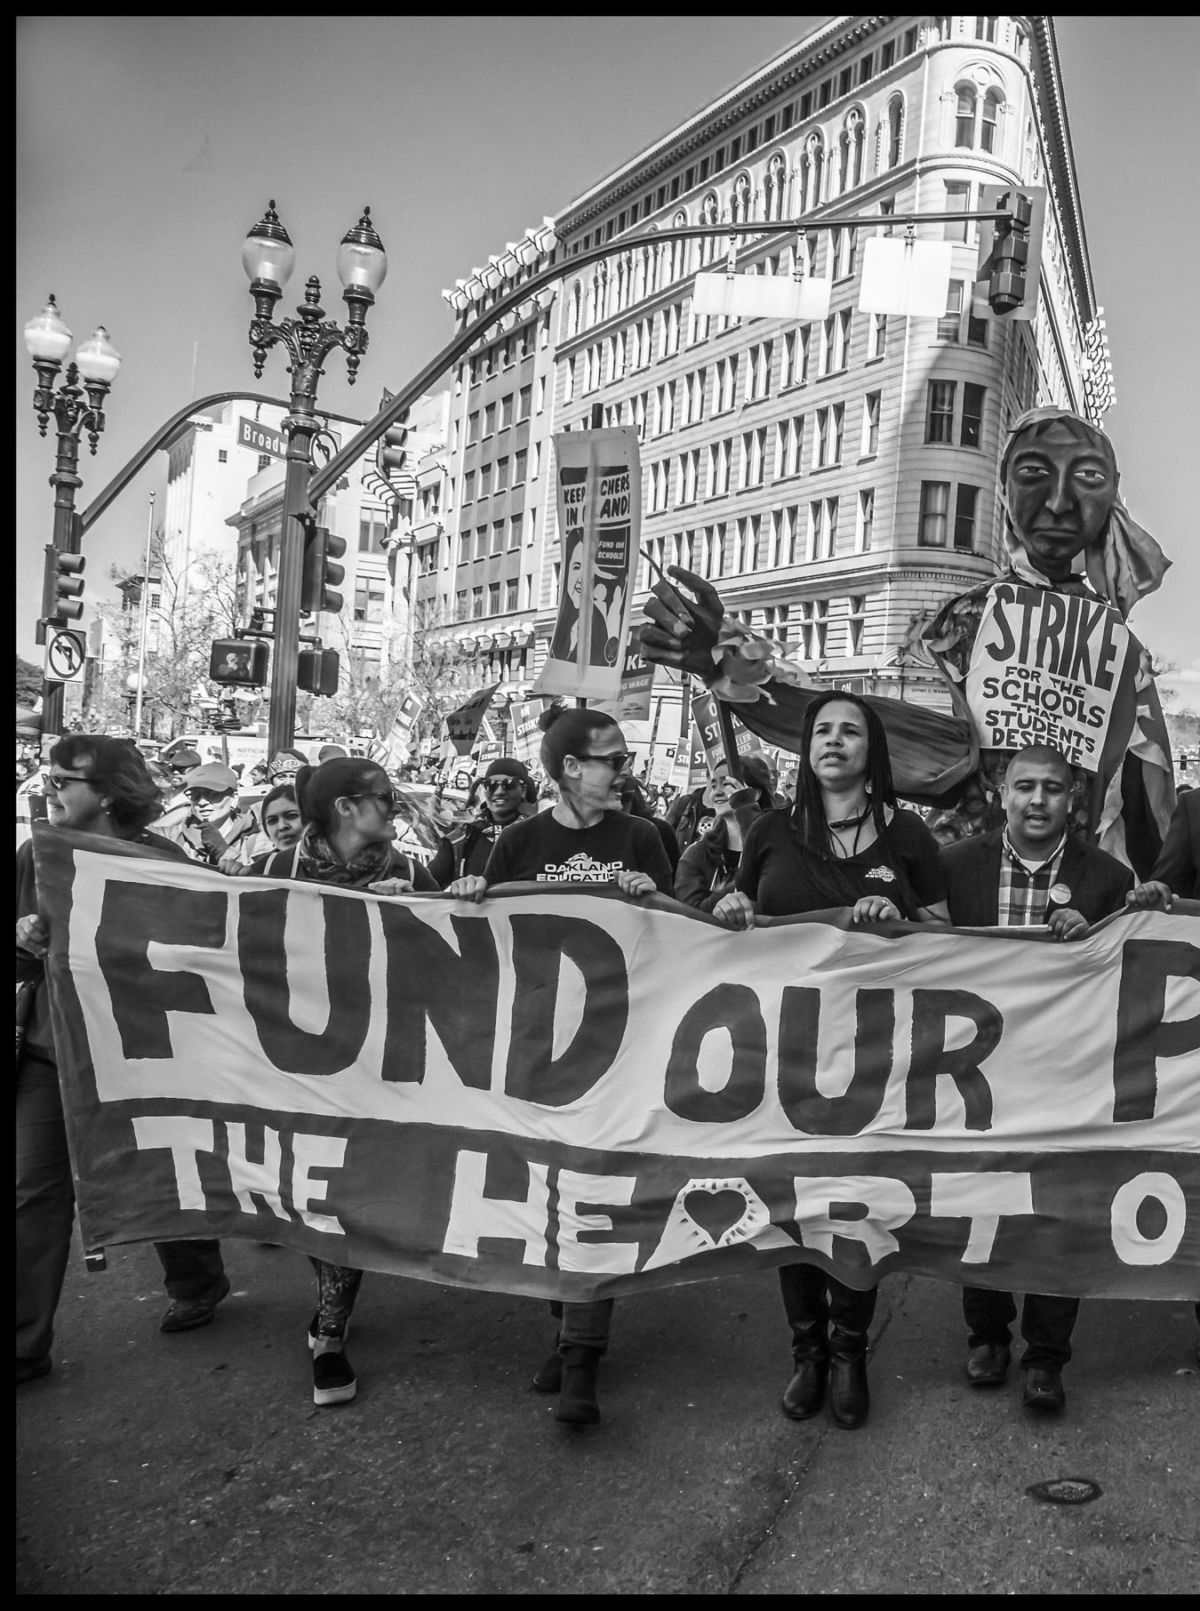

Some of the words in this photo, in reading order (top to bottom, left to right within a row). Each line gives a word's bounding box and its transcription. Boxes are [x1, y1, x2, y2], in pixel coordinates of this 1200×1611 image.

[566, 507, 578, 526] IN
[985, 584, 1126, 692] STRIKE
[629, 678, 649, 688] WAGE
[1005, 666, 1041, 683] FOR
[1049, 677, 1086, 698] THE
[983, 677, 1106, 728] SCHOOLS
[1011, 702, 1062, 723] THAT
[985, 710, 1095, 753] STUDENTS
[545, 861, 623, 873] OAKLAND
[95, 880, 628, 1107] FUND
[664, 983, 1003, 1136] OUR
[131, 1116, 348, 1234] THE
[443, 1149, 1033, 1276] HEART
